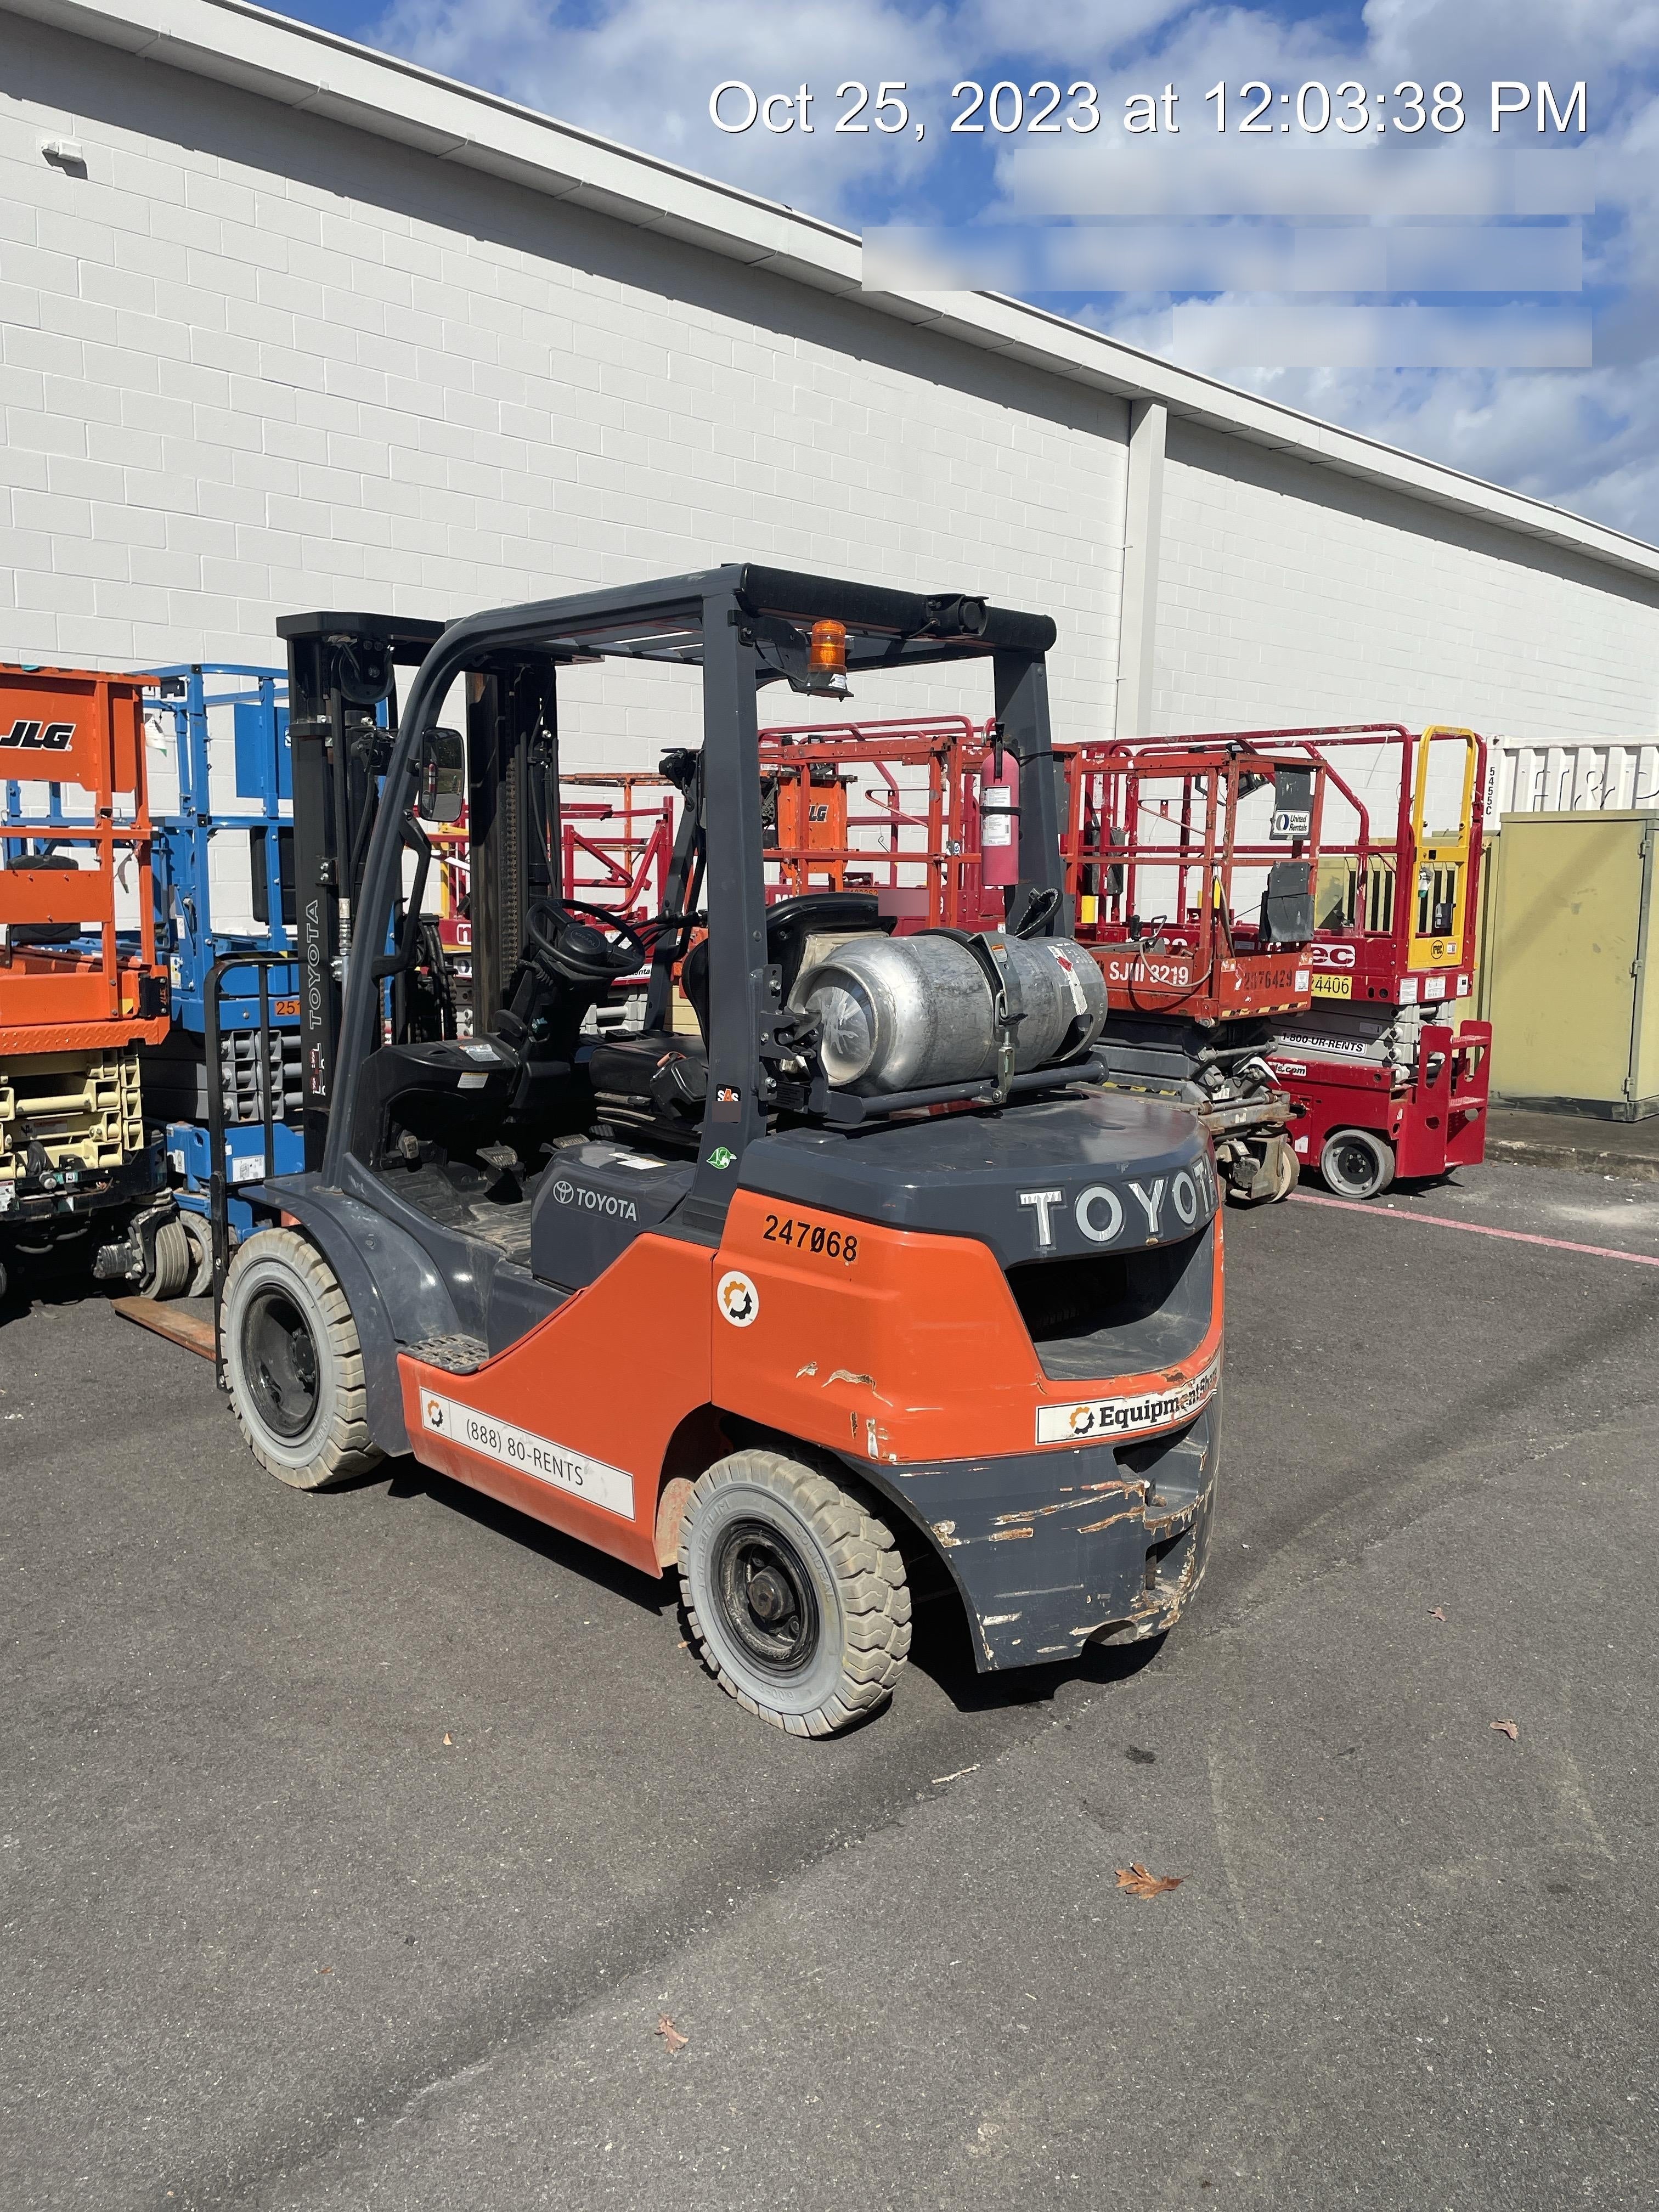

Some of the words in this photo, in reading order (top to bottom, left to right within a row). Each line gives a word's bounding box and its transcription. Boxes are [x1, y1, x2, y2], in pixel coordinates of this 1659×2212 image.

[0, 720, 76, 751] JLG
[809, 805, 828, 822] LG
[1290, 814, 1307, 823] United
[1289, 823, 1307, 831] Rentals
[306, 899, 324, 1030] TOYOTA
[1311, 947, 1355, 965] ec
[1152, 965, 1189, 985] 3219
[1282, 1032, 1363, 1052] 1-800-UR-RENTS
[577, 1188, 637, 1221] TOYOTA
[466, 1418, 501, 1453] (888)
[507, 1437, 584, 1486] 80-RENTS
[794, 1526, 834, 1602] SOLIDEAL
